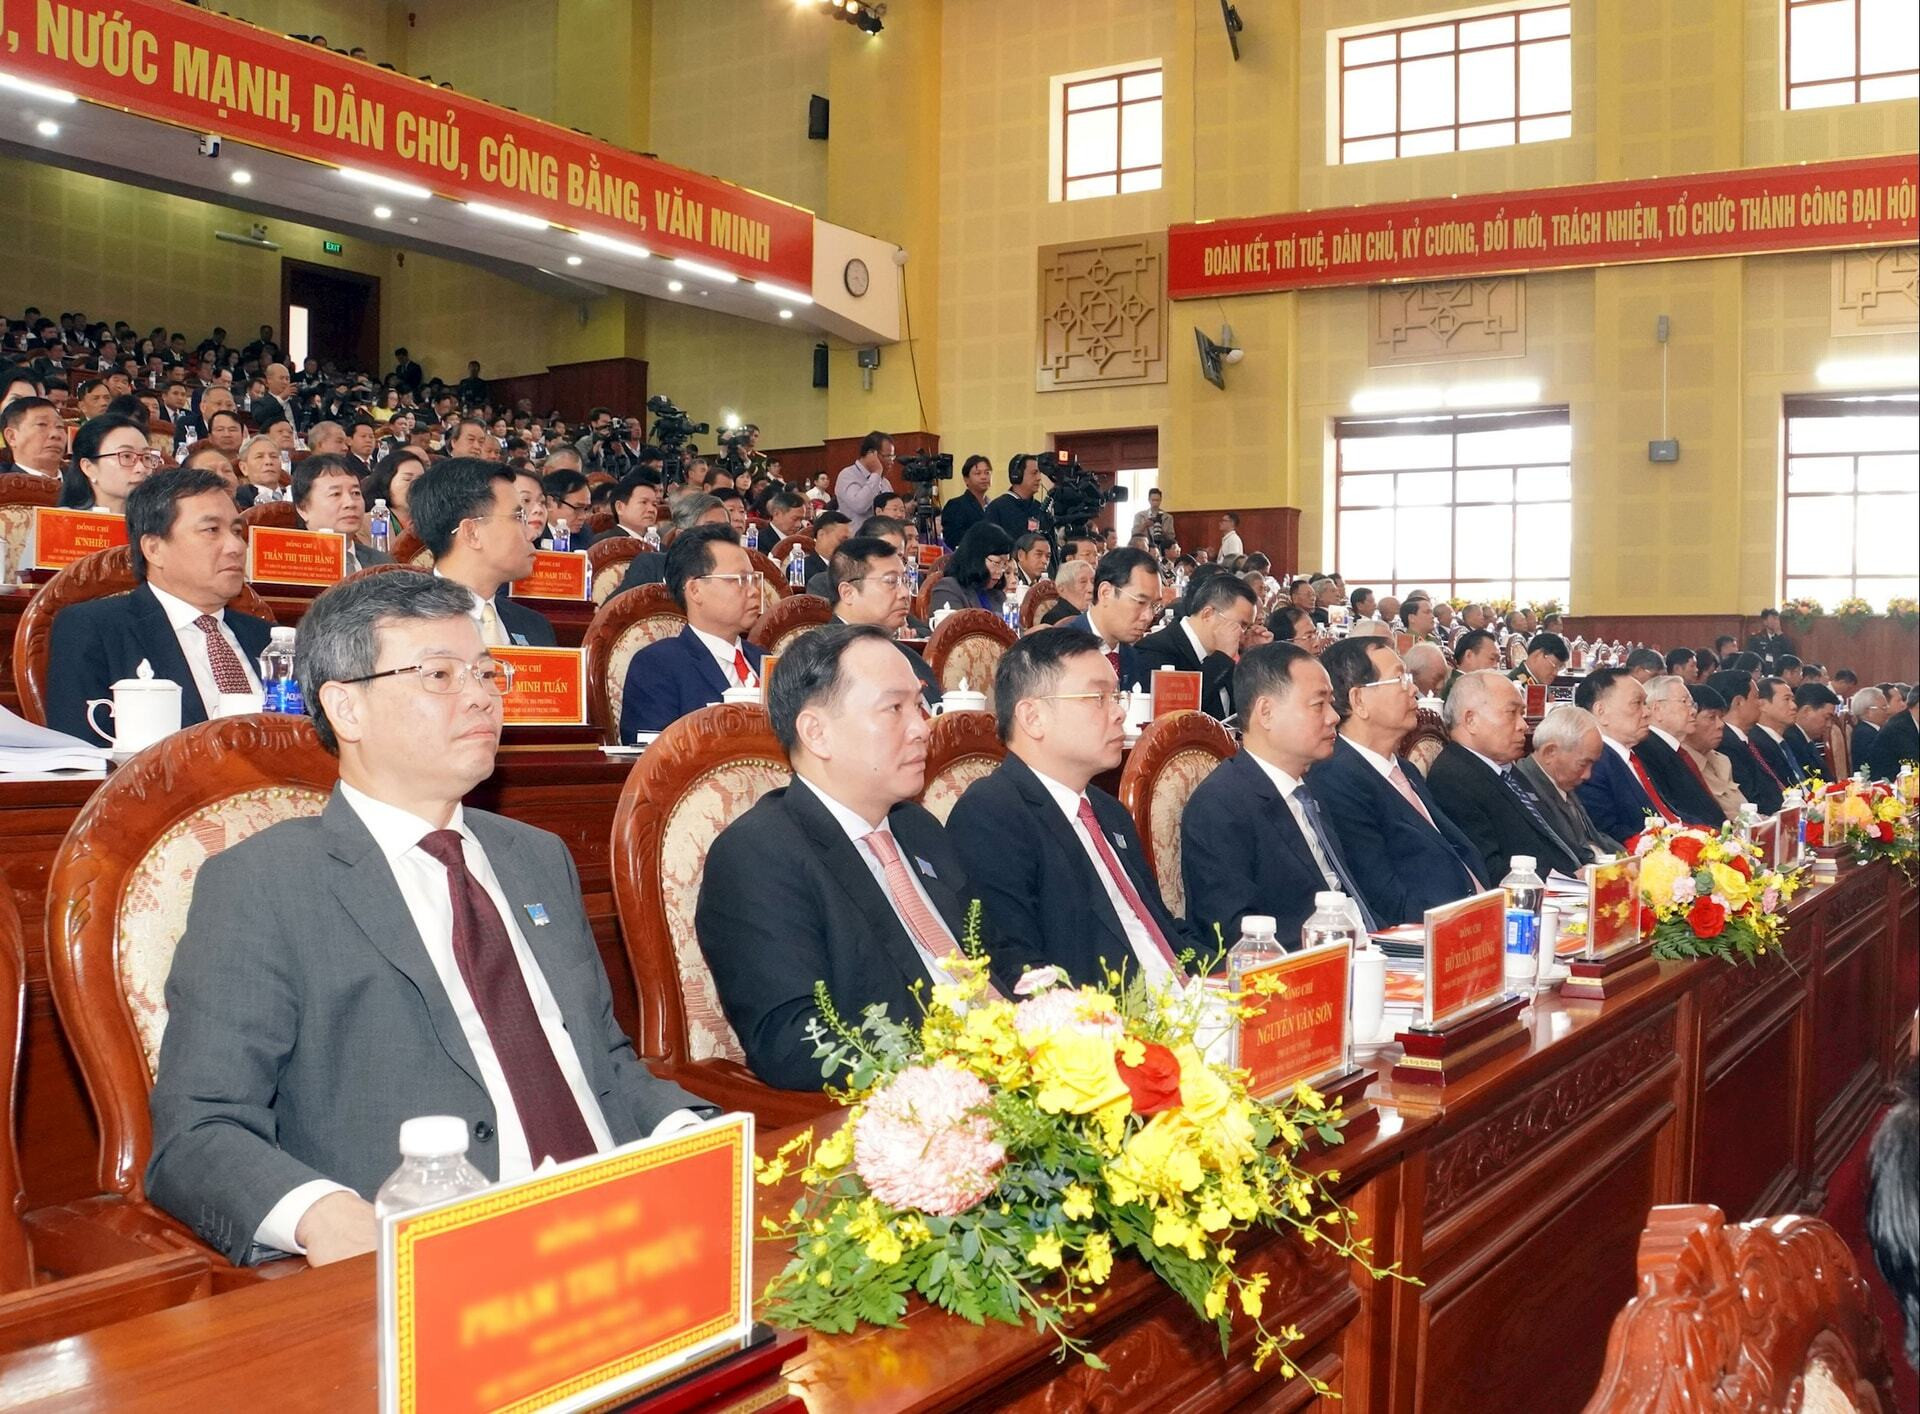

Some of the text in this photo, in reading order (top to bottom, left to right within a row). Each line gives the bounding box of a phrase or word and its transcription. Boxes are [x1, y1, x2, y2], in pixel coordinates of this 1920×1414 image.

[37, 0, 158, 85] NƯỚC
[173, 41, 300, 132] MẠNH,
[313, 83, 385, 151] DÂN
[396, 110, 469, 180] CHỦ,
[479, 134, 558, 201] CÔNG
[567, 153, 647, 232] BẰNG,
[655, 187, 703, 242] VĂN
[711, 208, 771, 263] MINH
[1204, 177, 1917, 277] ĐOÀN KẾT, TRÍ TUỆ, DÂN CHỦ, KỶ CƯƠNG, ĐỔI MỚI, TRÁCH NHIỆM, TỔ CHỨC THÀNH CÔNG ĐẠI HỘI
[516, 677, 568, 693] MINH TUẤN
